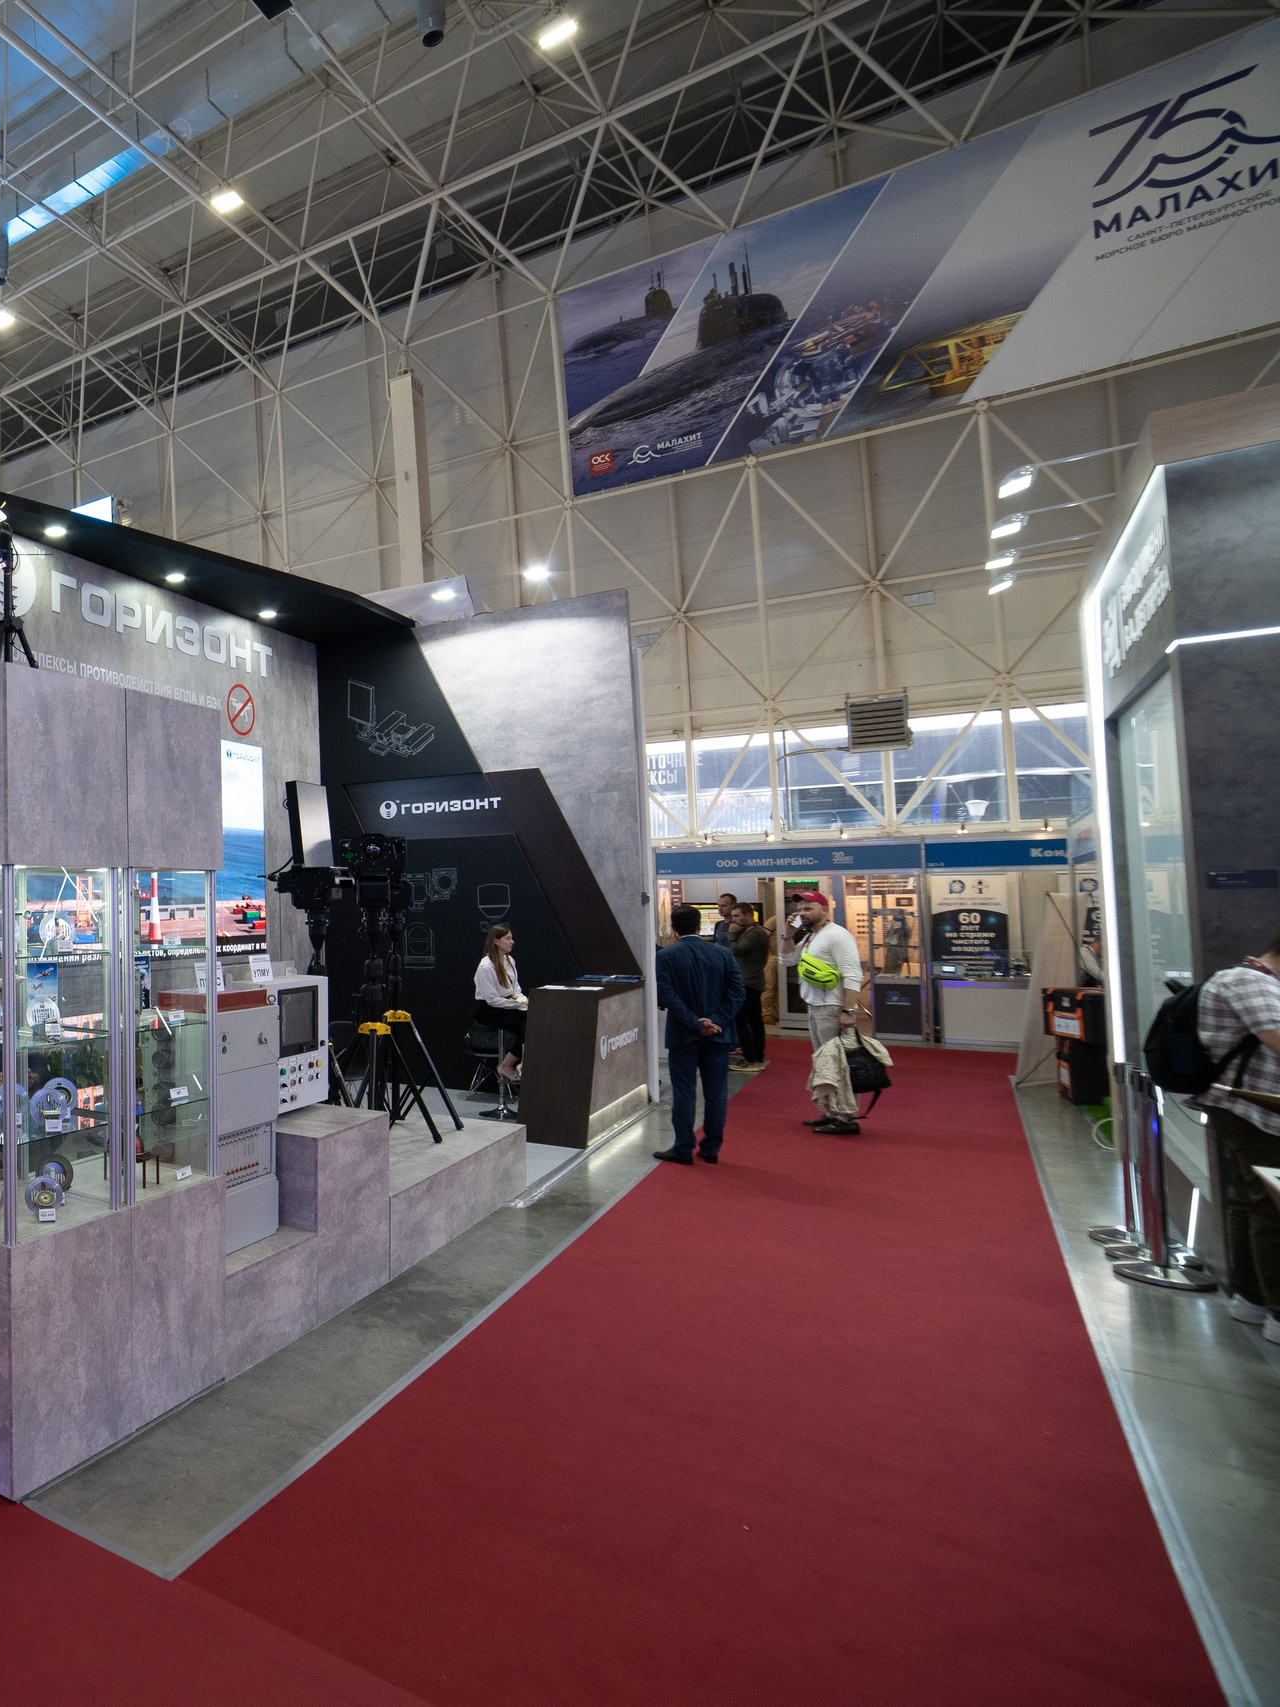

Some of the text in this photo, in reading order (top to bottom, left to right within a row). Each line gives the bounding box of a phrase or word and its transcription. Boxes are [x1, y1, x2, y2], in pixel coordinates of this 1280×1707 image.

[1093, 158, 1279, 239] МАЛАХИ
[1128, 190, 1272, 242] САНКТ-ПЕТЕРБУРГСКОЕ
[1095, 241, 1147, 262] МОРСКОЕ
[1150, 228, 1184, 244] БЮРО
[657, 432, 702, 450] МАЛАХИТ
[591, 453, 610, 465] ОСК
[51, 569, 273, 678] ГОРИЗОНТ
[13, 646, 77, 675] ОМПЛЕКСЫ
[80, 663, 171, 699] ПРОТИВОДЕЙСТВИЯ
[401, 797, 501, 815] ГОРИЗОНТ
[716, 859, 739, 868] ООО
[743, 856, 818, 867] «ММП-ИРБИС»
[958, 912, 981, 924] 60
